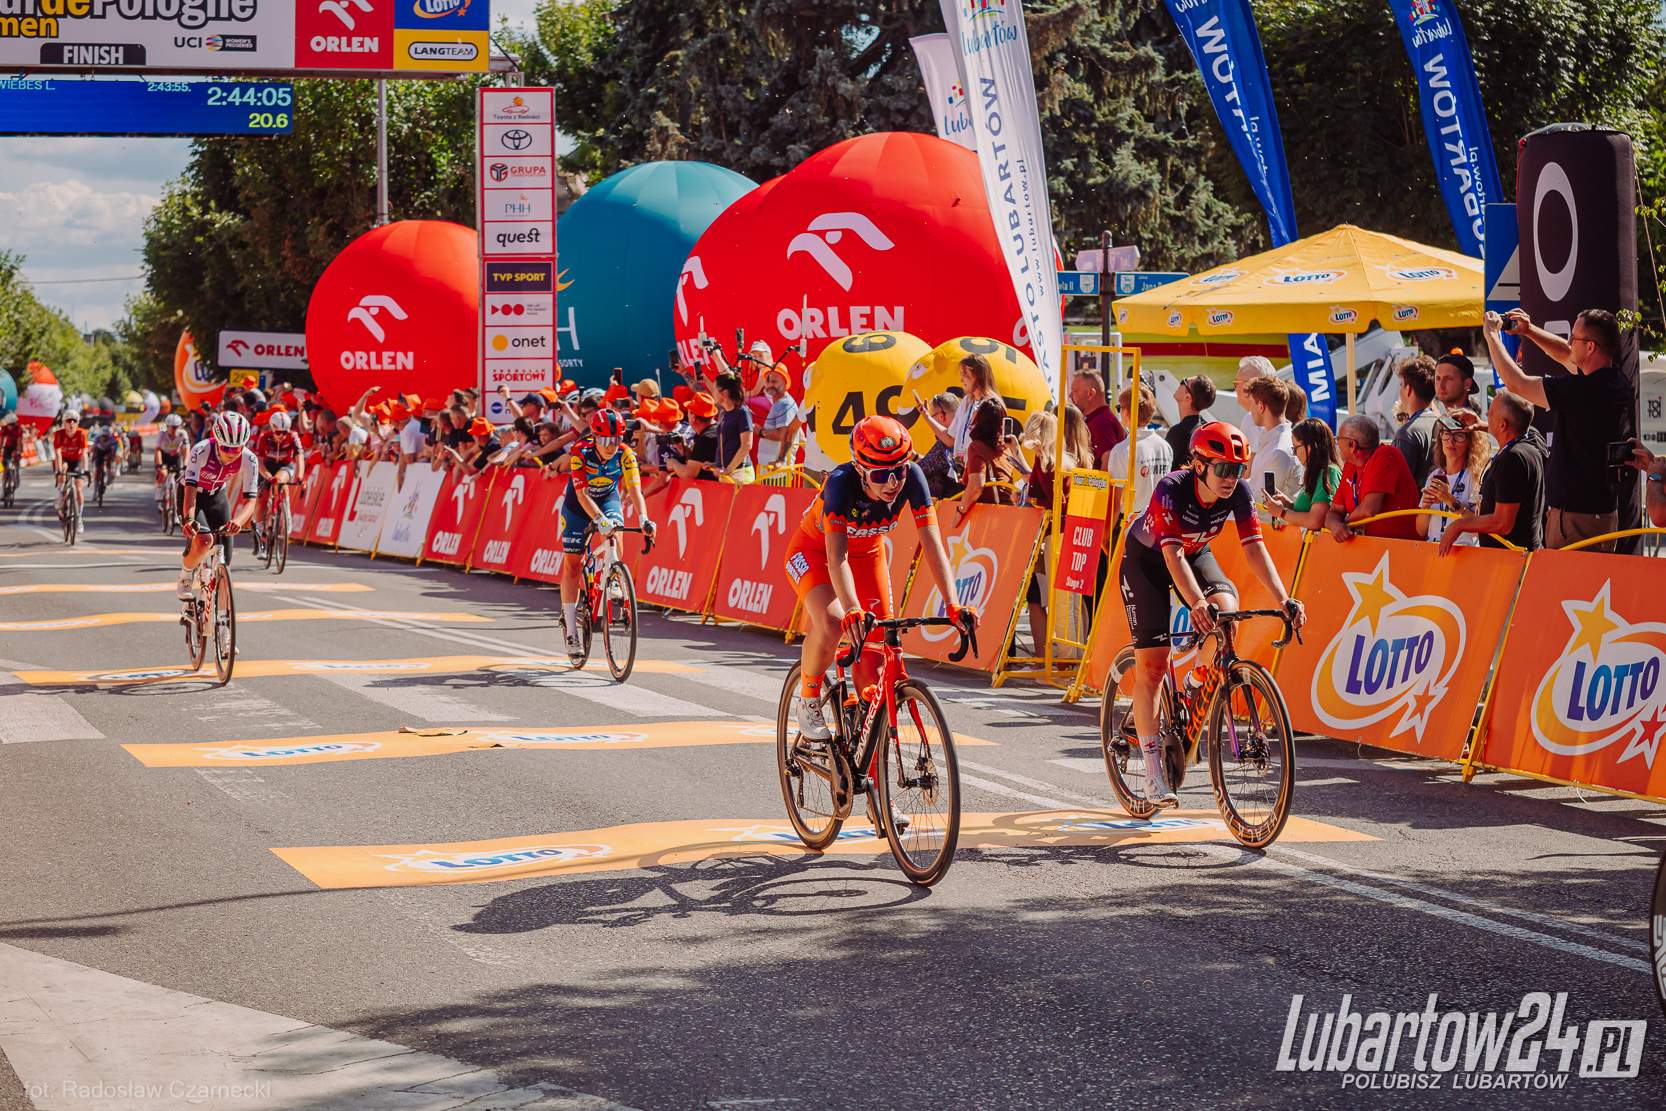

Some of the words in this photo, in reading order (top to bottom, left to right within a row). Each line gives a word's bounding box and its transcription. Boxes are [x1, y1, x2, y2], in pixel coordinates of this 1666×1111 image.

[0, 16, 58, 37] men
[174, 36, 202, 48] UCI
[310, 35, 379, 53] ORLEN
[63, 45, 124, 65] FINISH
[207, 86, 292, 106] 2:44:05
[248, 112, 289, 129] 20.6
[510, 166, 546, 175] GRUPA
[979, 77, 1030, 275] LUBARTÓW
[505, 203, 531, 214] PHH
[496, 227, 541, 248] quest
[493, 272, 513, 282] TVP
[514, 272, 546, 282] SPORT
[1283, 272, 1330, 283] LOTTO
[776, 305, 904, 340] ORLEN
[1212, 313, 1229, 323] LOTTO
[1335, 310, 1353, 321] LOTTO
[1398, 307, 1414, 318] LOTTO
[254, 343, 306, 358] ORLEN
[511, 335, 546, 348] onet
[340, 350, 415, 371] ORLEN
[492, 373, 546, 382] SPORTOWY
[431, 529, 463, 556] ORLEN
[1072, 525, 1094, 548] CLUB
[482, 539, 512, 564] ORLEN
[529, 547, 564, 575] ORLEN
[1070, 551, 1088, 572] TDP
[646, 565, 694, 600] ORLEN
[727, 577, 774, 615] ORLEN
[1345, 630, 1435, 696] LOTTO
[1566, 656, 1661, 722] LOTTO
[241, 742, 344, 758] LOTTO
[431, 847, 564, 870] LOTTO
